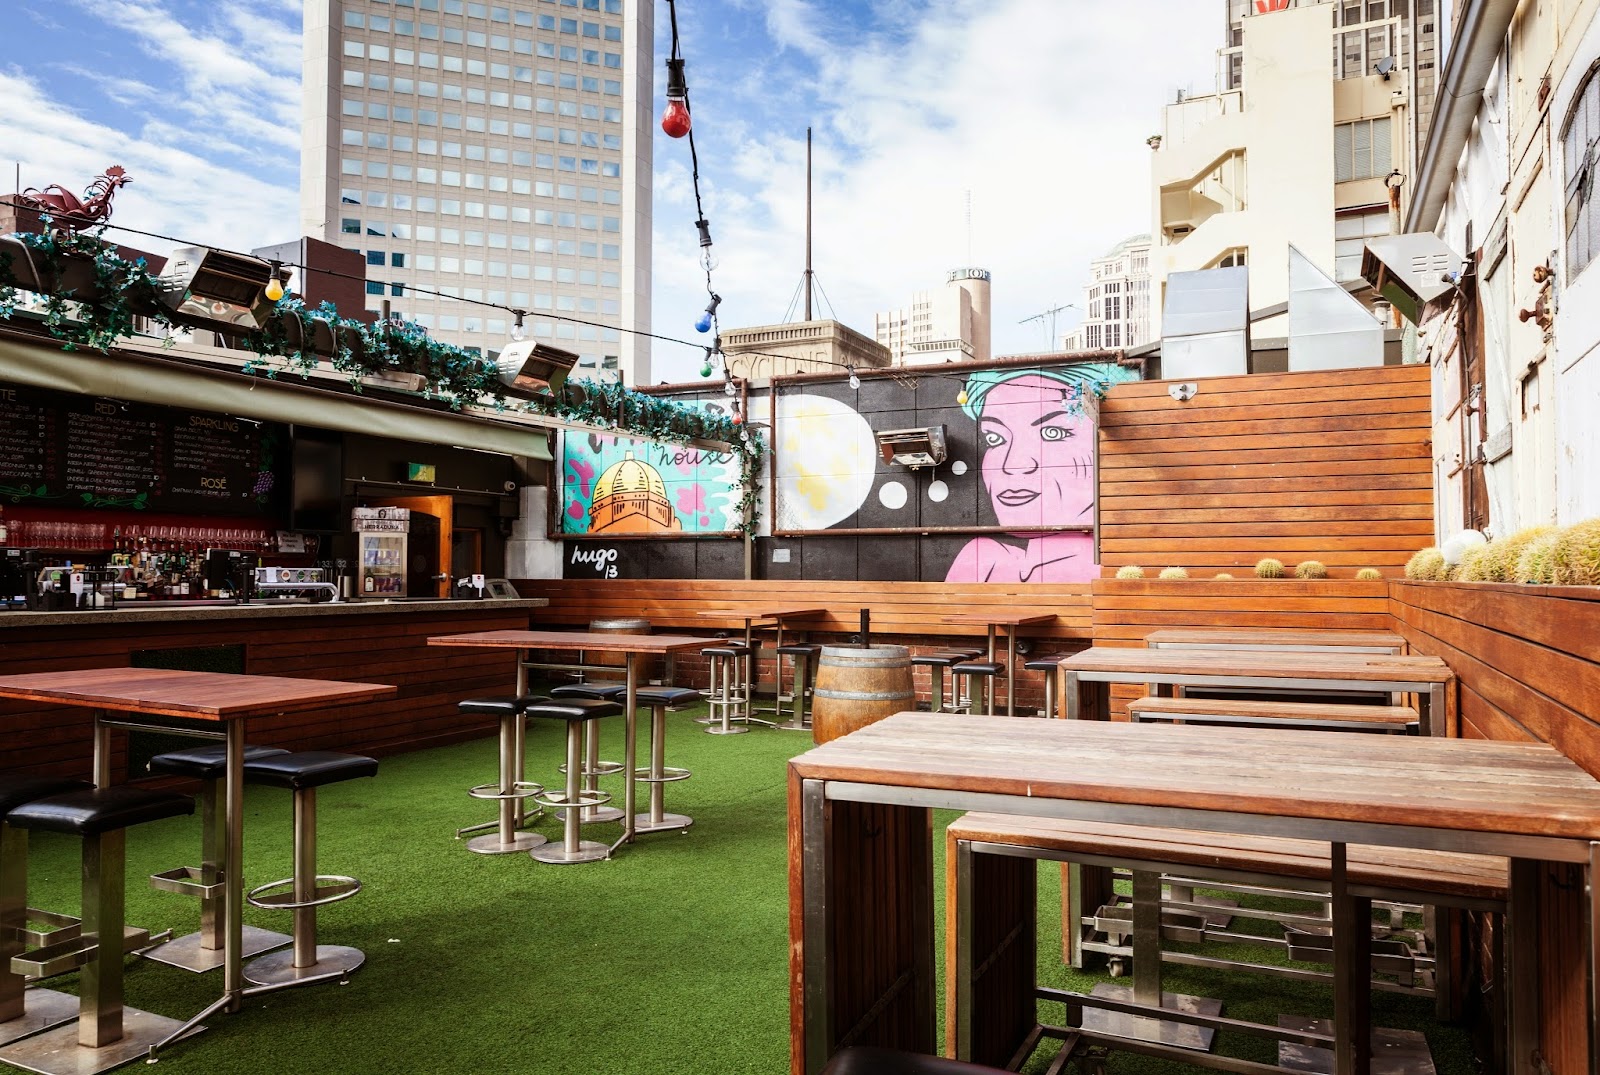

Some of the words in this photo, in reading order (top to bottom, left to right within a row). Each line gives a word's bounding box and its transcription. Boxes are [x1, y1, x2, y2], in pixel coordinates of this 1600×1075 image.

[94, 402, 117, 415] RED
[188, 415, 240, 433] SPARKLING
[659, 445, 734, 466] house
[200, 476, 227, 490] ROSÉ
[570, 544, 618, 571] hugo
[605, 564, 619, 580] 13
